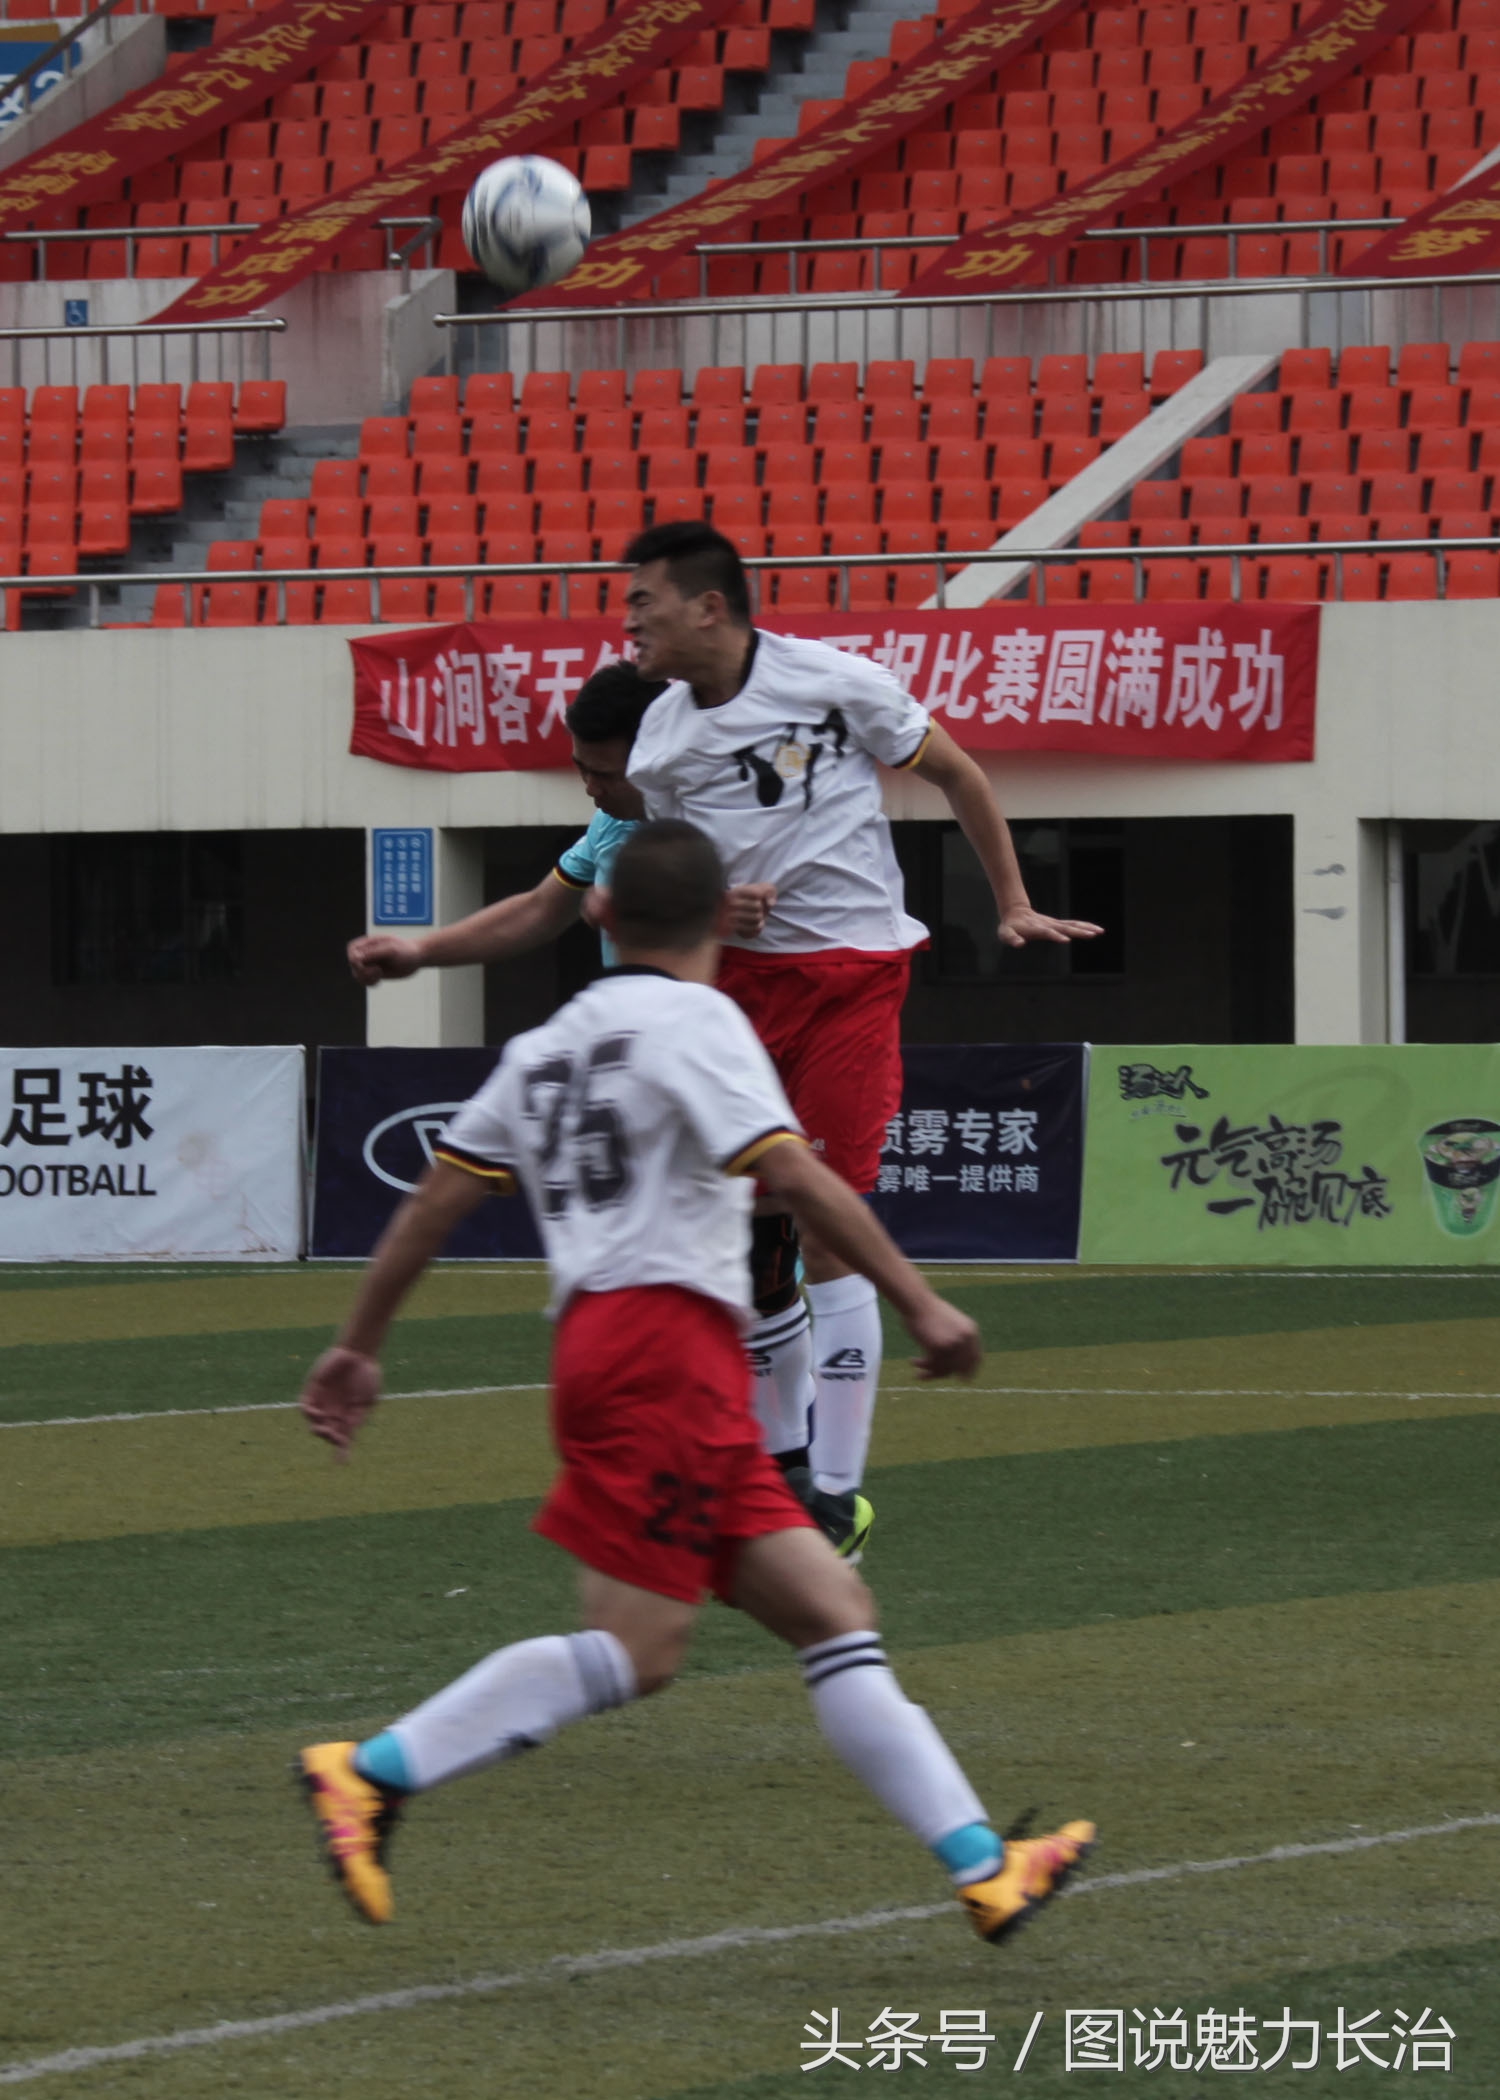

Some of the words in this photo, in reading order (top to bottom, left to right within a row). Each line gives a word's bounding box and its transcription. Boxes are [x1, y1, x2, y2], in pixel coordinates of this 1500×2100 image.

[818, 627, 1286, 732] 祝比赛圆满成功
[0, 1064, 154, 1148] 足球
[872, 1164, 1040, 1194] 雾唯一提供商
